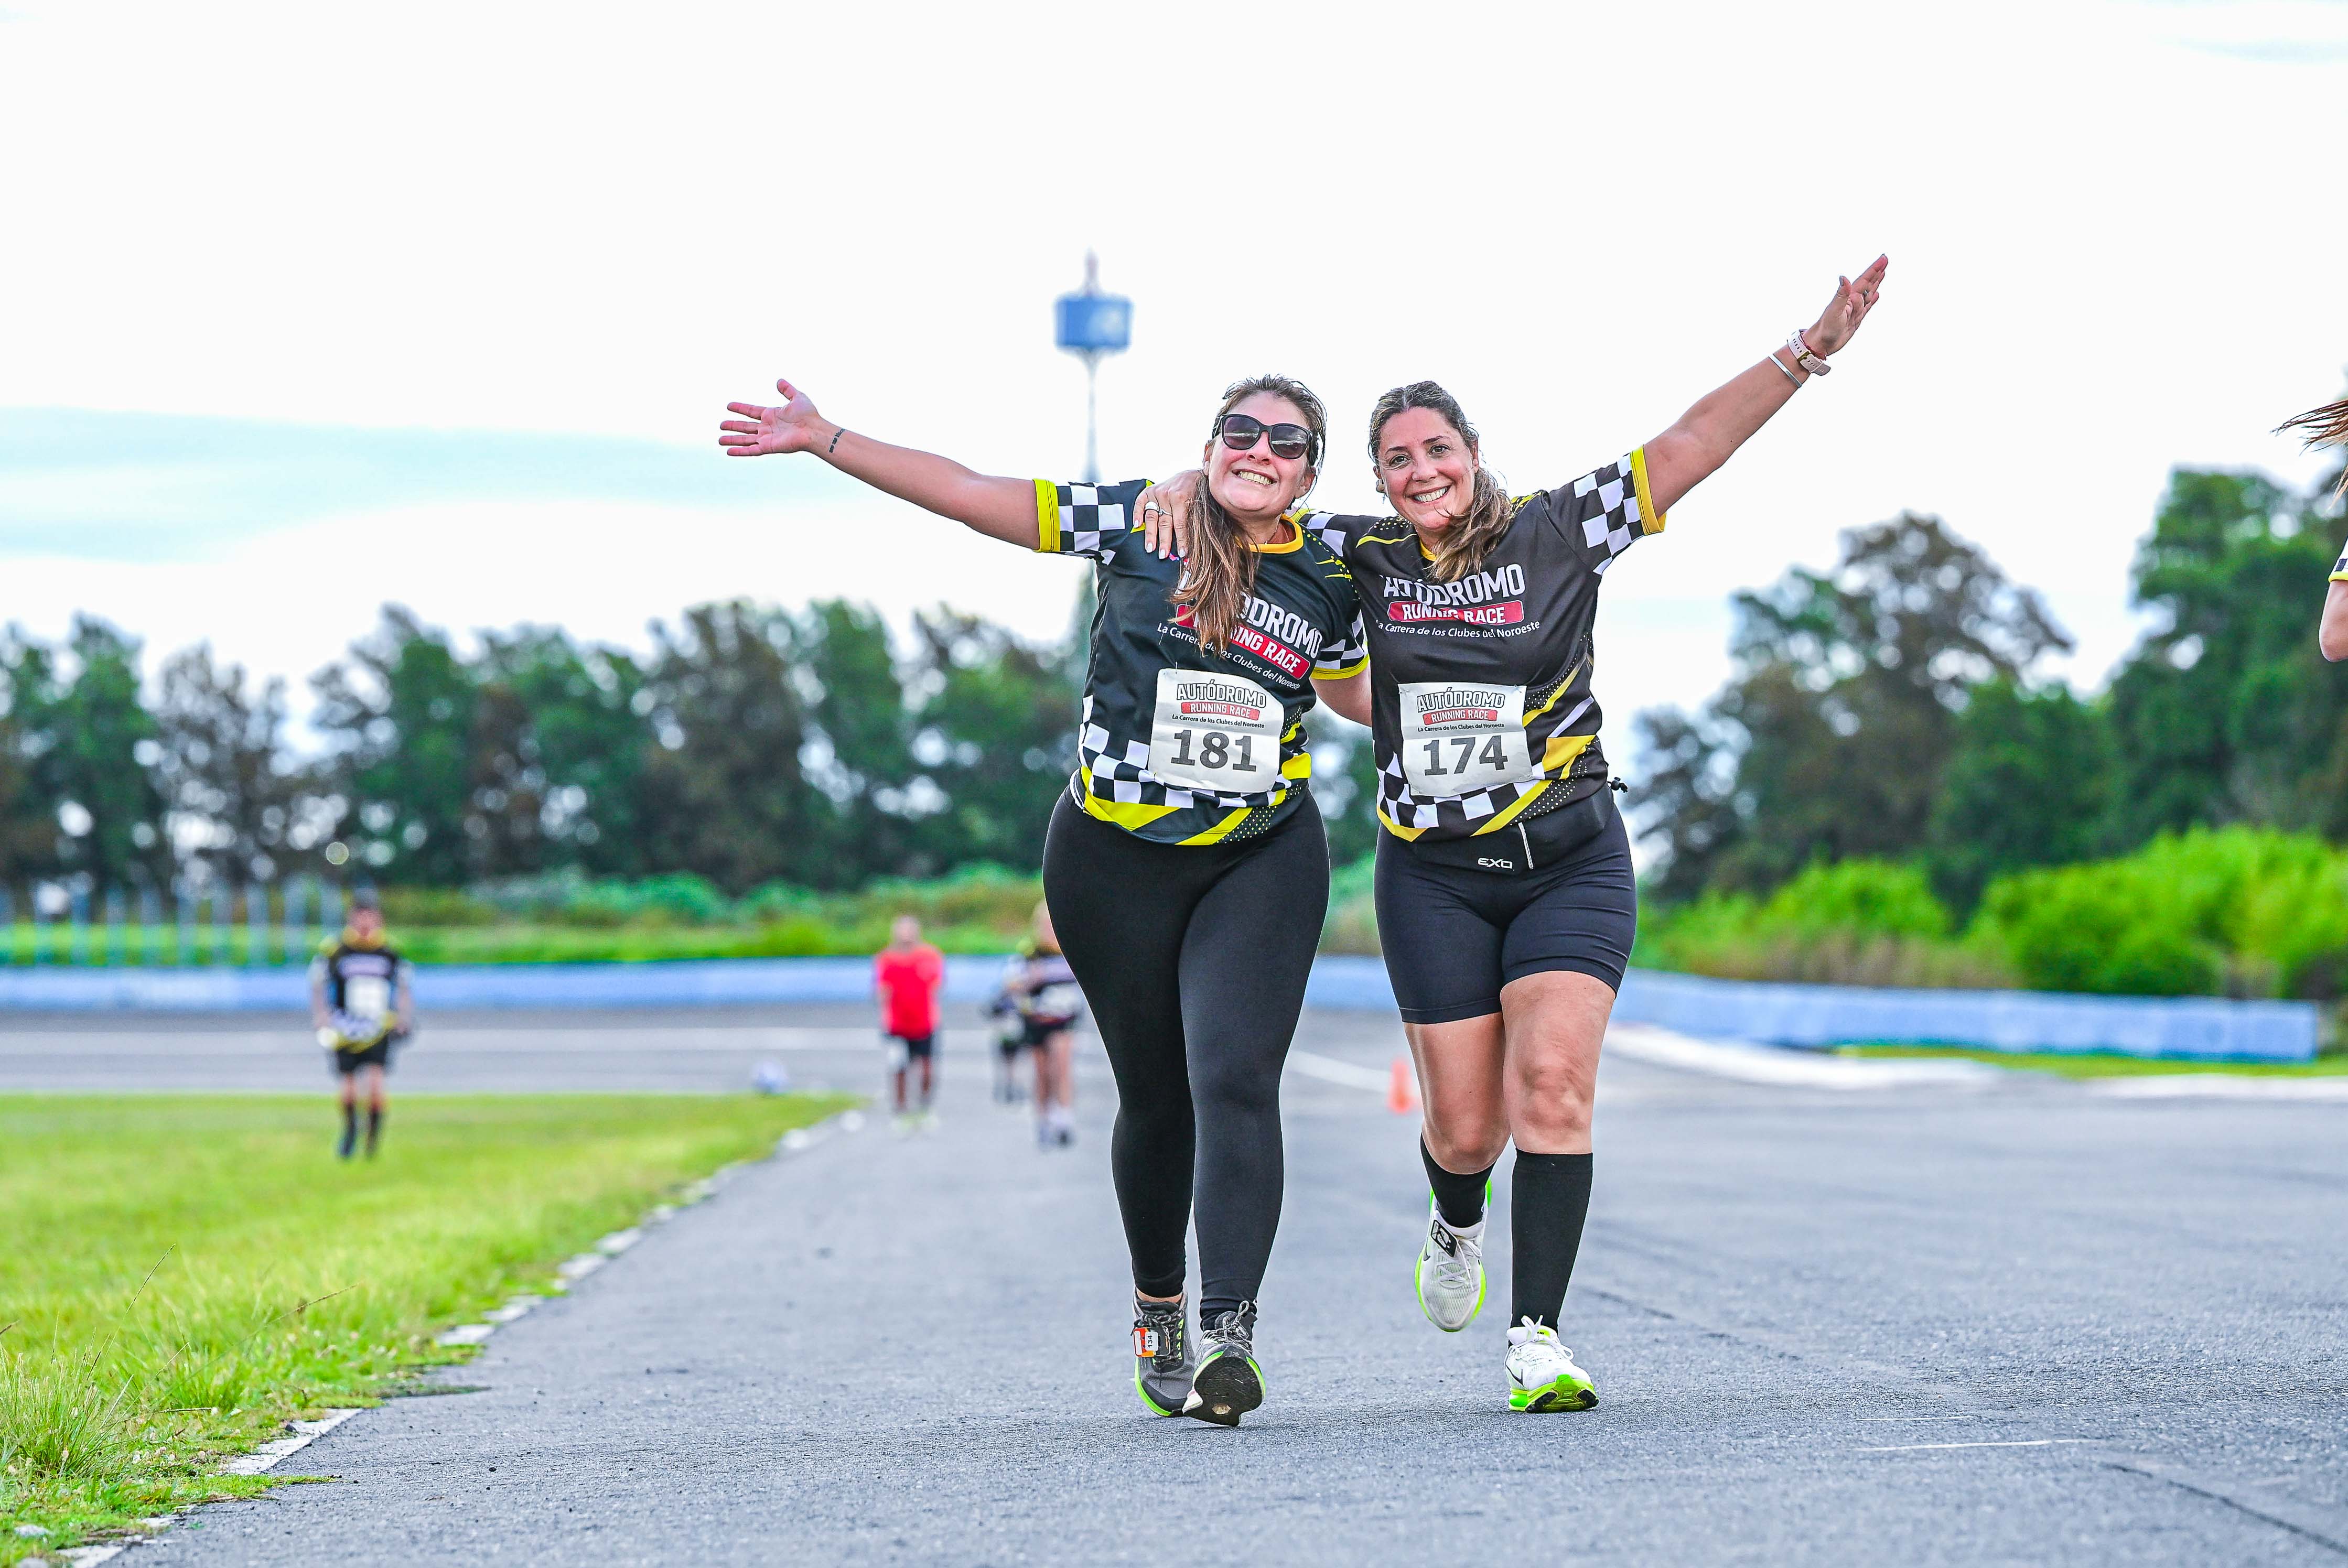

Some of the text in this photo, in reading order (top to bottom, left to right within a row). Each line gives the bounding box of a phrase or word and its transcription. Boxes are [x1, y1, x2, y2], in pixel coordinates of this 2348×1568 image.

[1463, 607, 1505, 624] RACE
[1376, 620, 1383, 628] a
[1385, 623, 1415, 634] Carrera
[1448, 628, 1480, 637] Clubes
[1482, 629, 1495, 637] del
[1497, 621, 1540, 637] Noroeste
[1157, 622, 1168, 633] La
[1221, 650, 1232, 658] os
[1233, 655, 1262, 673] Clubes
[1263, 669, 1278, 680] del
[1263, 641, 1300, 673] RACE
[1177, 679, 1266, 708] AUTÓDROMO
[1417, 687, 1505, 712] AUTÓDROMO
[1190, 703, 1251, 718] RUNNING RACE
[1431, 710, 1488, 723] RUNNING RACE
[1171, 729, 1256, 772] 181
[1424, 735, 1508, 776] 174
[1478, 858, 1513, 869] EXO
